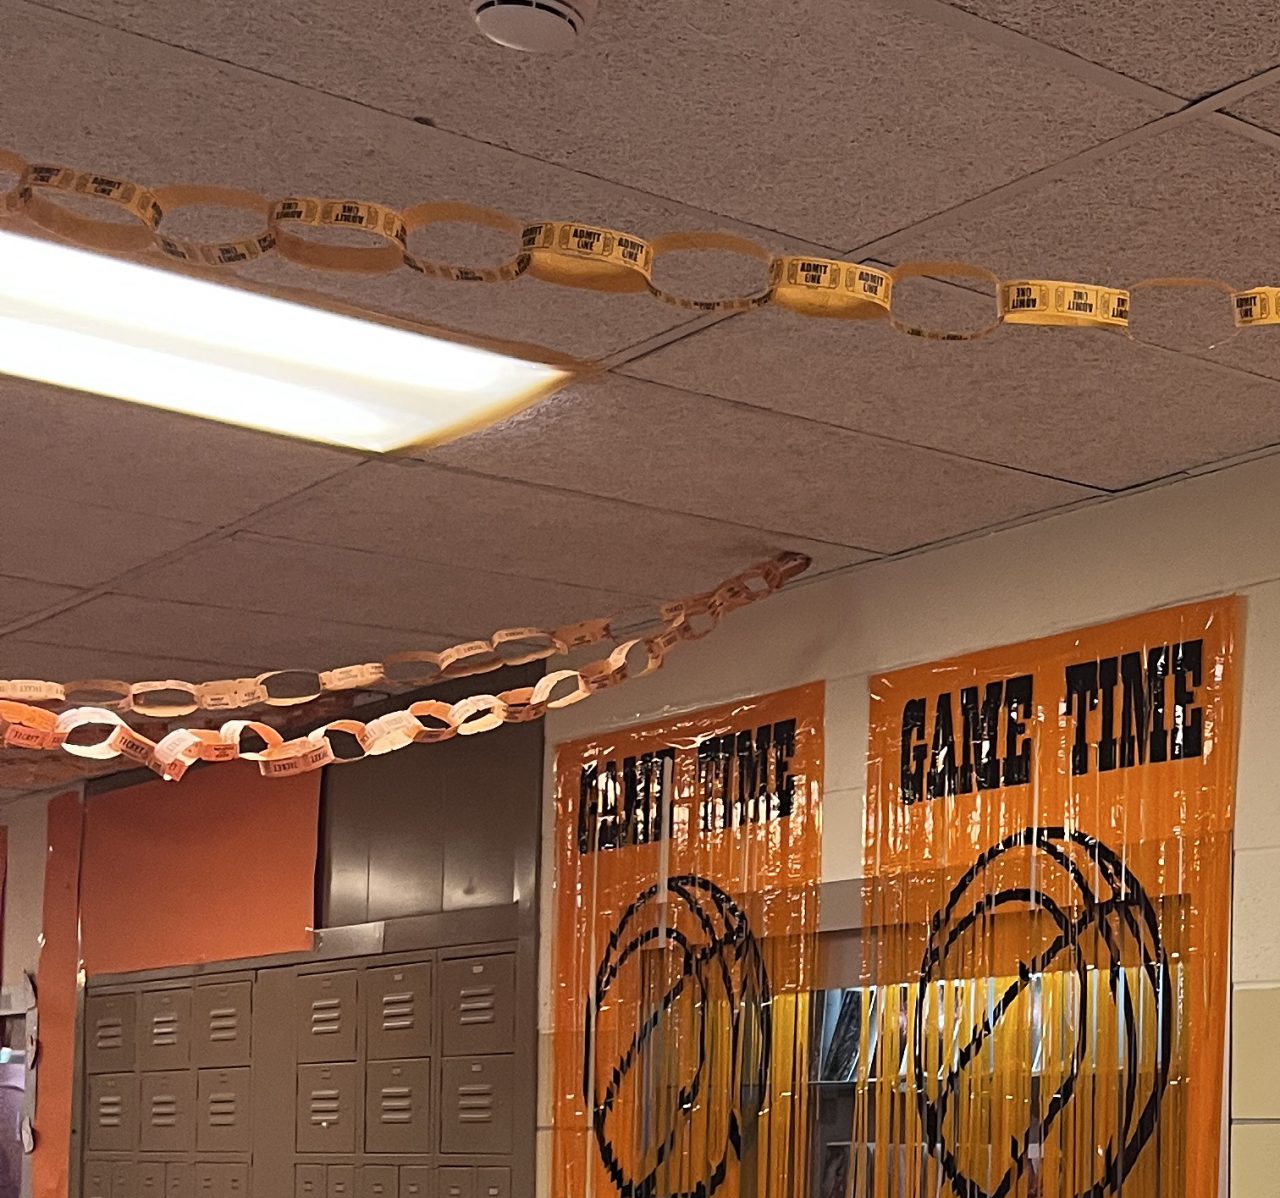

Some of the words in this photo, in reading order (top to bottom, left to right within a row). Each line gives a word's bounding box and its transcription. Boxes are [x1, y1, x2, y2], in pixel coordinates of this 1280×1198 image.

[573, 228, 602, 243] ADMIT
[577, 240, 595, 251] ONE
[618, 237, 645, 255] ADMIT
[800, 261, 829, 275] ADMIT
[804, 273, 822, 285] ONE
[858, 270, 884, 286] ADMIT
[862, 283, 878, 297] ONE
[1016, 287, 1032, 298] ONE
[901, 672, 1034, 806] GAME
[1062, 638, 1204, 777] TIME
